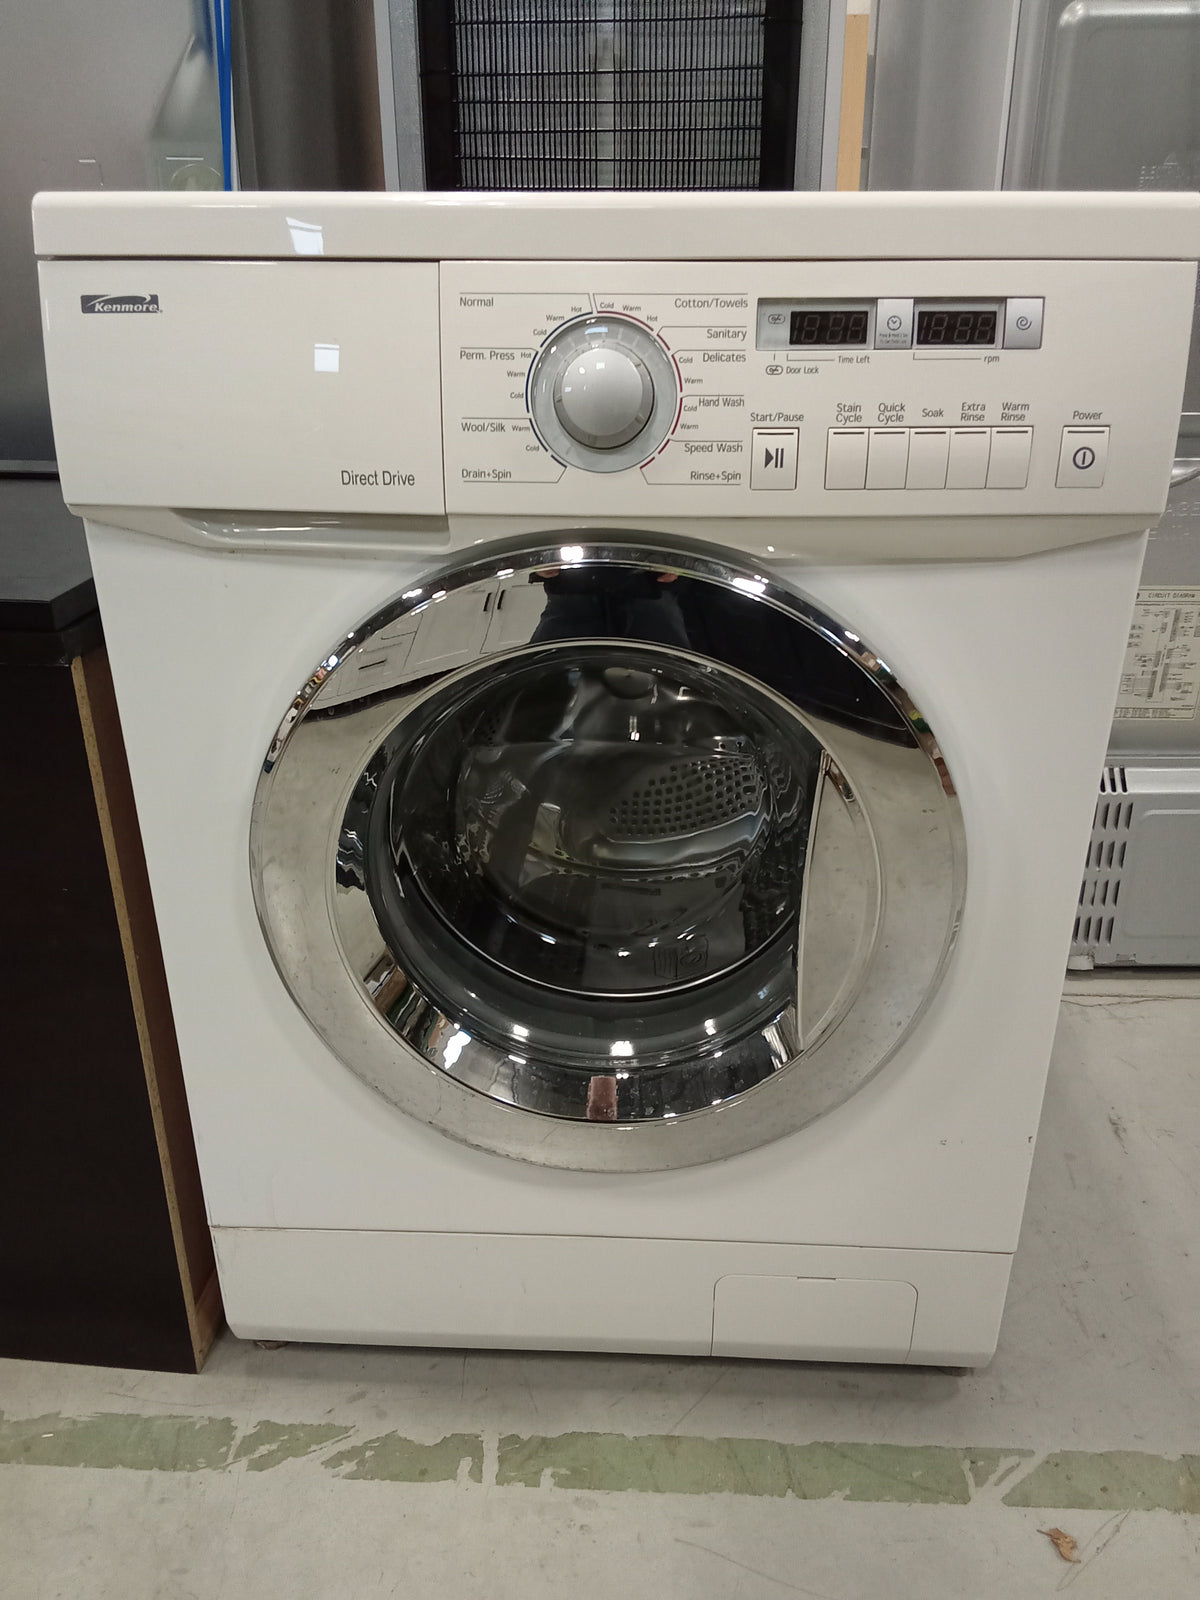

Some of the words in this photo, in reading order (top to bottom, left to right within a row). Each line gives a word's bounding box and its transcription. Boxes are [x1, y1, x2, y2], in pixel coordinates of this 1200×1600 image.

[94, 302, 158, 312] Kenmore
[460, 298, 494, 307] Normal
[675, 298, 748, 308] Cotton/Towels
[707, 329, 747, 340] Sanitary
[460, 351, 487, 360] Perm.
[489, 351, 515, 360] Press
[703, 353, 746, 362] Delicates
[838, 356, 854, 364] Time
[856, 356, 870, 364] Left
[786, 366, 801, 374] Door
[804, 366, 819, 374] Lock
[699, 398, 719, 406] Hand
[722, 398, 744, 407] Wash
[962, 402, 986, 411] Extra
[1002, 402, 1029, 411] Warm
[837, 403, 861, 412] Stain
[879, 403, 905, 413] Quick
[751, 413, 804, 423] Start/Pause
[922, 409, 944, 418] Soak
[961, 412, 985, 421] Rinse
[1001, 412, 1025, 421] Rinse
[1072, 411, 1102, 420] Power
[836, 413, 862, 424] Cycle
[878, 413, 904, 424] Cycle
[461, 423, 505, 432] Wool/Silk
[684, 443, 714, 453] Speed
[716, 443, 743, 452] Wash
[341, 470, 379, 485] Direct
[383, 470, 415, 486] Drive
[462, 470, 511, 480] Drain+Spin
[690, 471, 741, 481] Rinse+Spin
